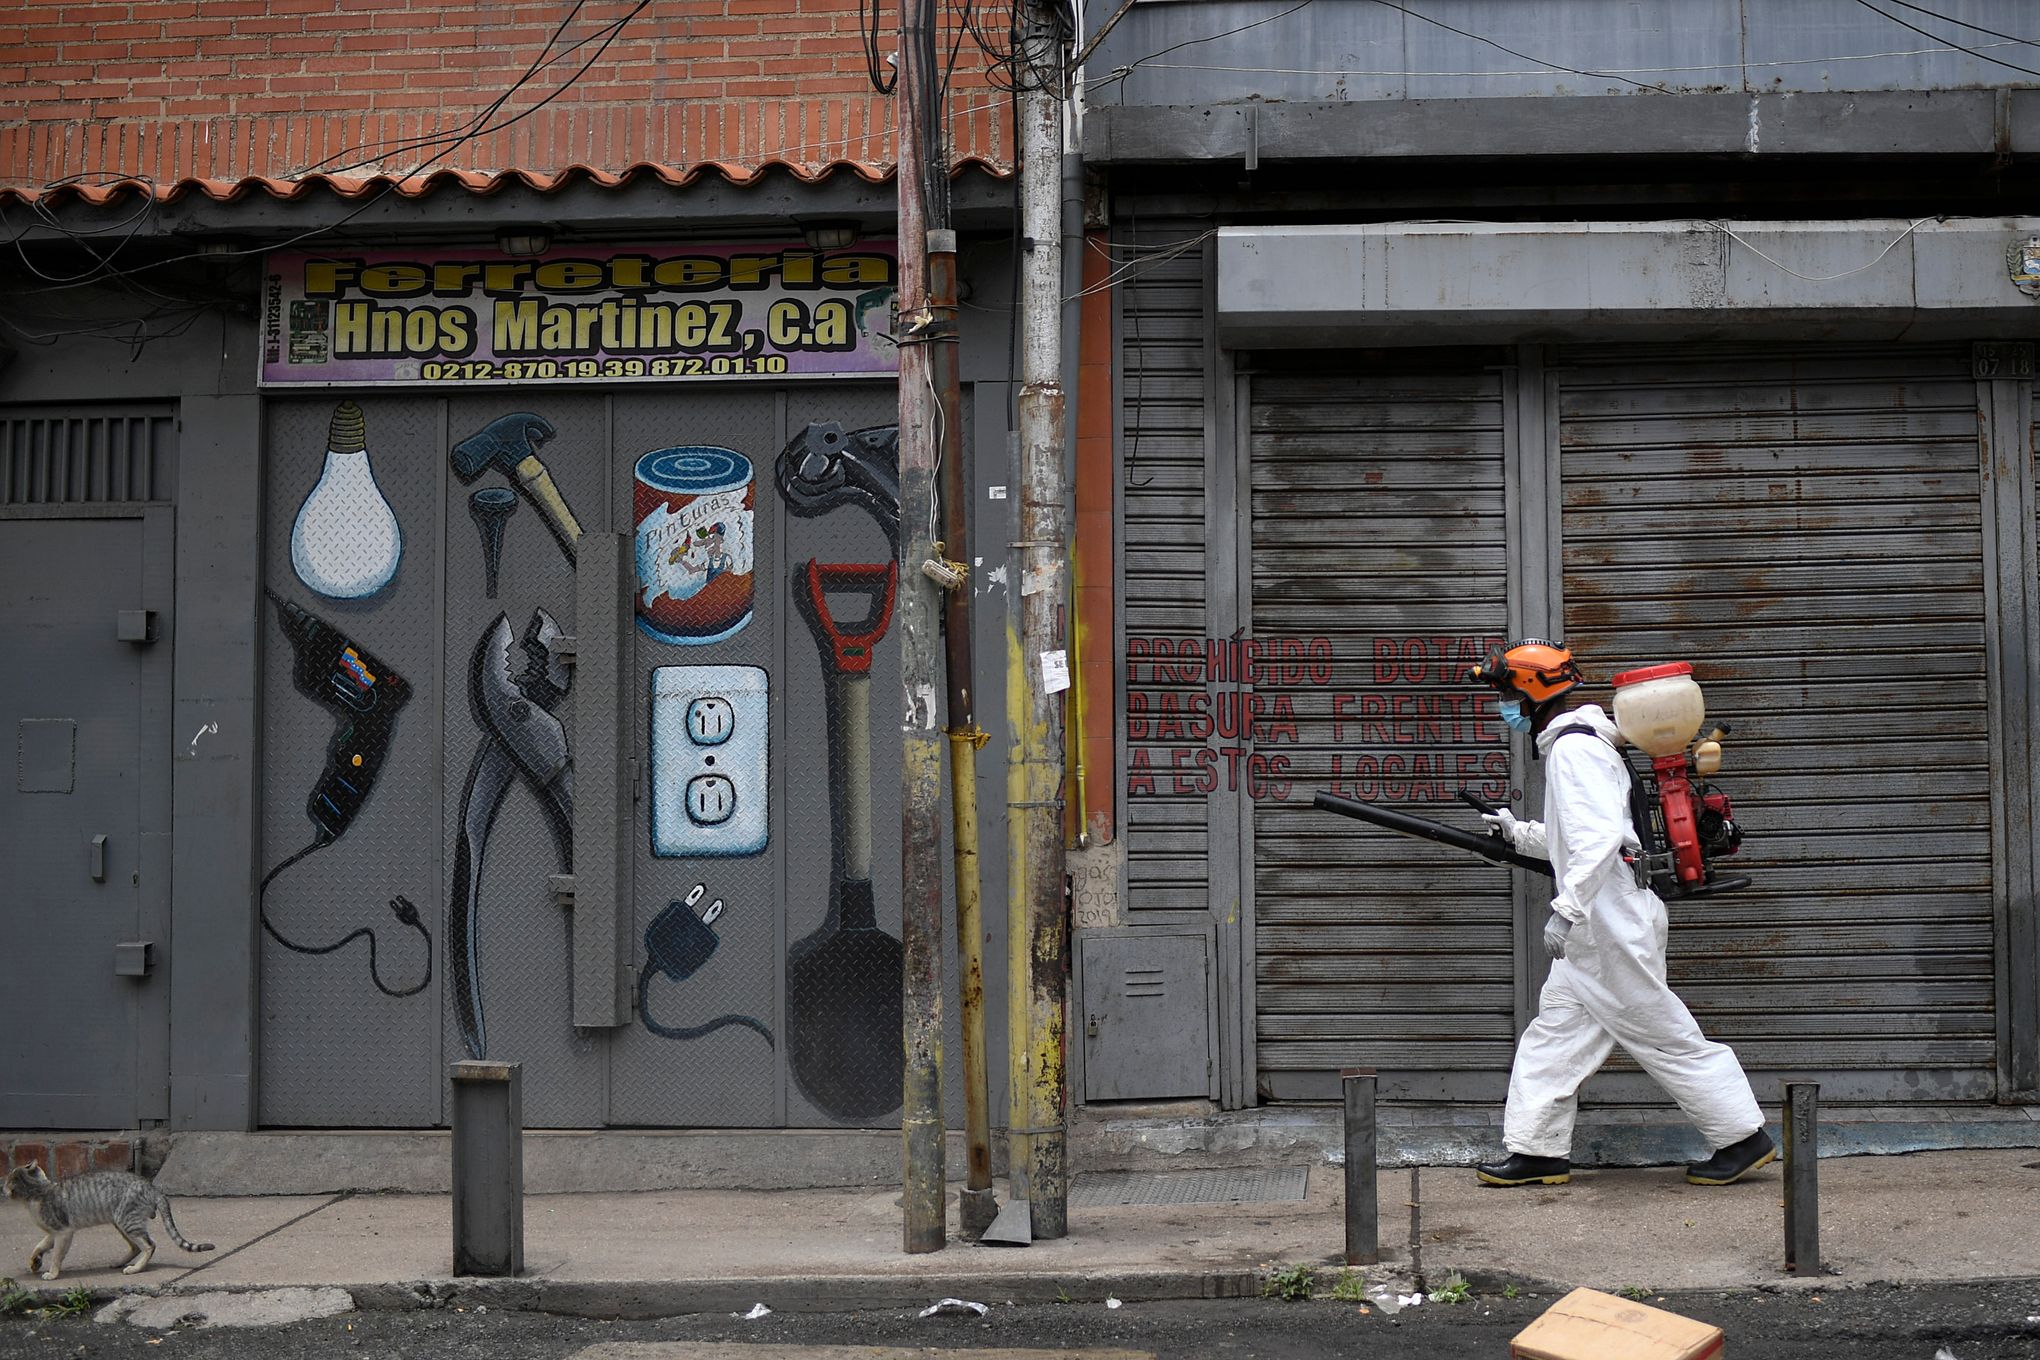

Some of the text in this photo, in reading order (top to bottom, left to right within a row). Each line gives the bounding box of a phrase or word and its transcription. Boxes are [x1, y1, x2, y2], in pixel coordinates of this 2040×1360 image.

[305, 250, 891, 296] Ferreteria
[335, 301, 470, 355] Hnos
[423, 356, 786, 380] 0212-870.19.39 872.01.10
[643, 494, 730, 555] Pinturas
[1127, 692, 1502, 743] BASURA FRENTE
[1127, 747, 1156, 795] A
[1171, 747, 1293, 801] ESTOS
[1077, 909, 1111, 924] 2019
